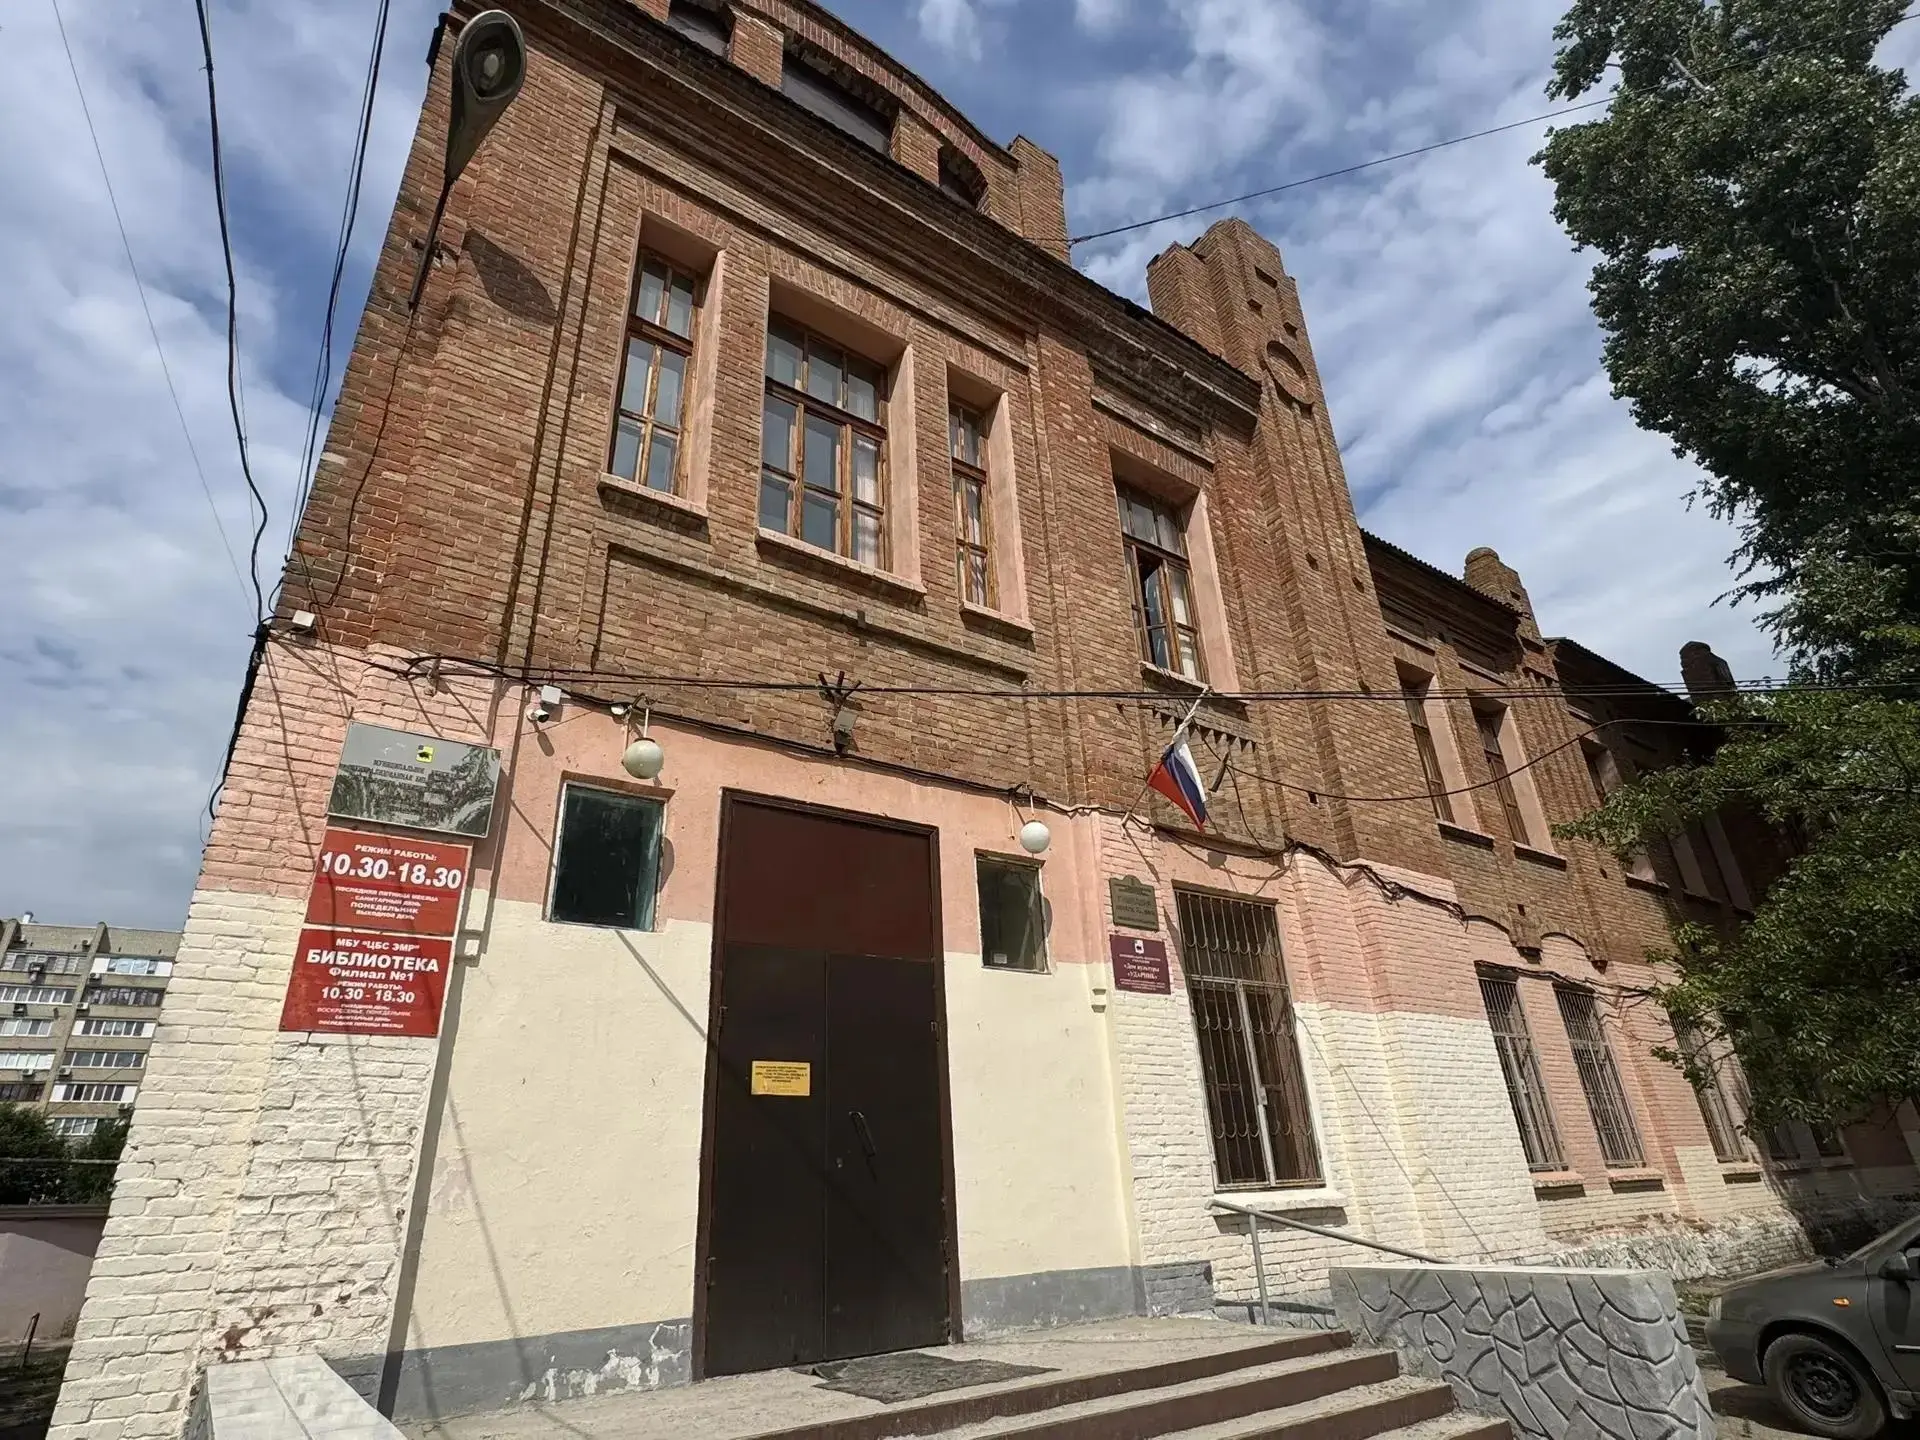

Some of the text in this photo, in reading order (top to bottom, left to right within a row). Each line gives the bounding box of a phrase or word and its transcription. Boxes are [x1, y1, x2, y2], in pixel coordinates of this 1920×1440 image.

[354, 844, 438, 861] РЕЖИМ РАБОТЫ:
[350, 901, 419, 914] ПОНЕДЕЛЬНИК
[335, 938, 360, 948] МБУ
[306, 949, 439, 972] БИБЛИОТЕКА
[328, 966, 414, 982] Филиал №1
[321, 986, 364, 1000] 10.30
[375, 989, 415, 1003] 18.30
